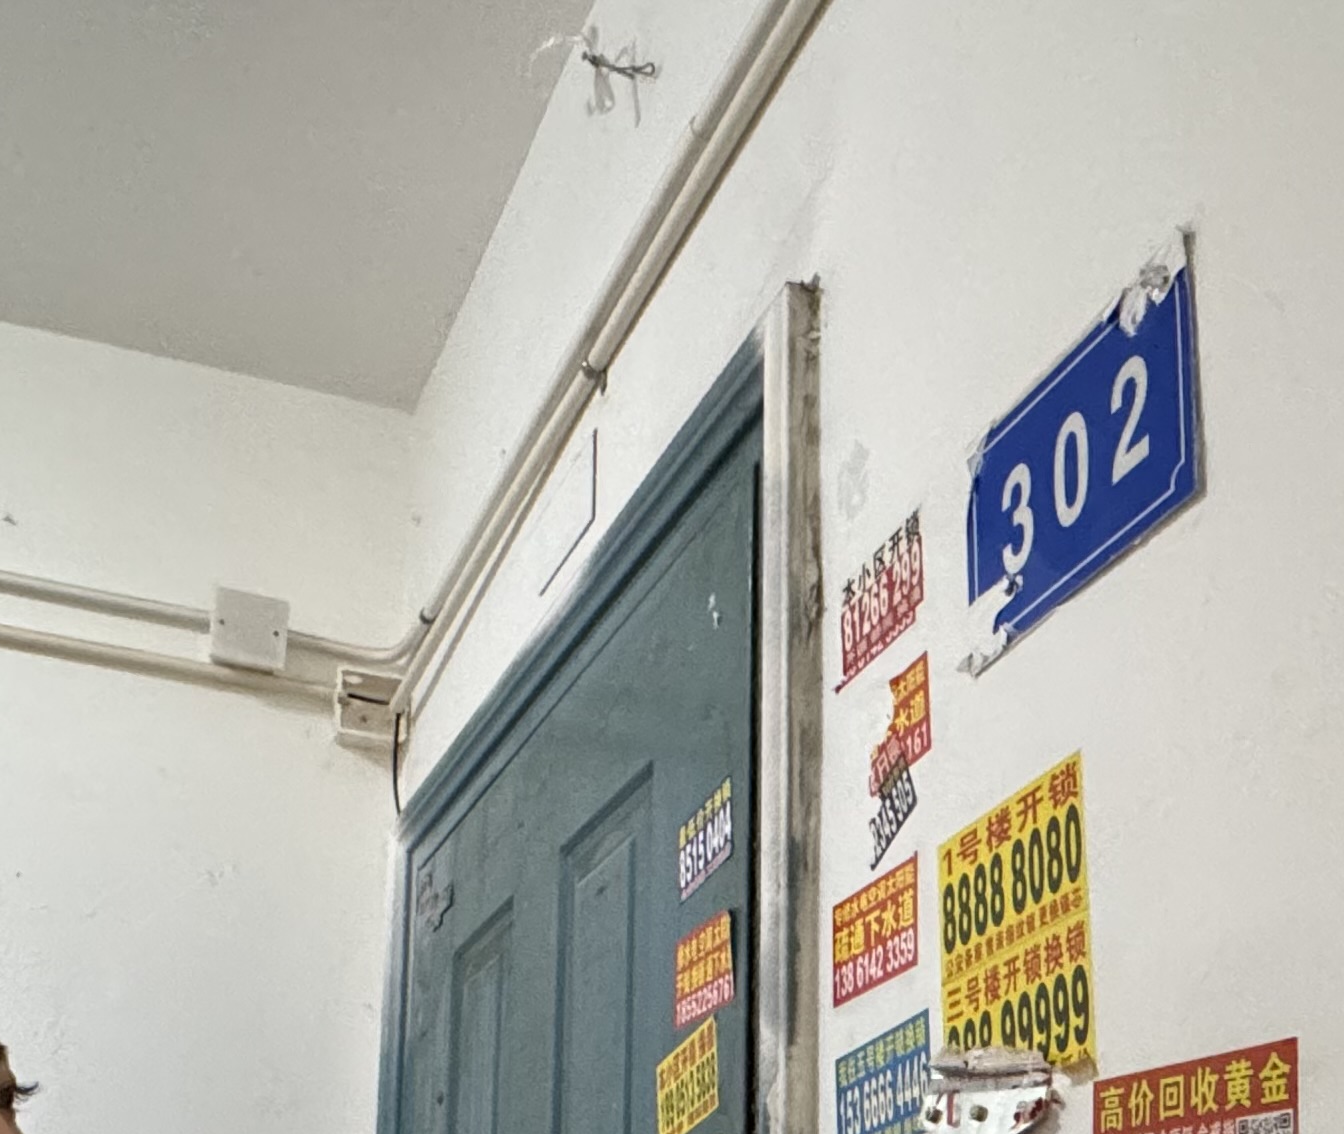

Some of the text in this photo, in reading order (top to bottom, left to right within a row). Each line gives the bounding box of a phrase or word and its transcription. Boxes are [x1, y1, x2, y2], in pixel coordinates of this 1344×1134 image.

[1001, 356, 1149, 575] 302
[892, 660, 926, 701] 太阳能
[902, 722, 927, 762] 161
[944, 761, 1078, 876] 1号楼开锁
[680, 830, 704, 888] 8515
[944, 803, 1082, 954] 8888 8080
[835, 890, 914, 961] 疏通下水道
[835, 928, 914, 998] 138 6142 3359
[946, 920, 1087, 1023] 三号楼开锁换锁
[864, 1070, 893, 1131] 6666
[1100, 1052, 1291, 1133] 高价回收黄金
